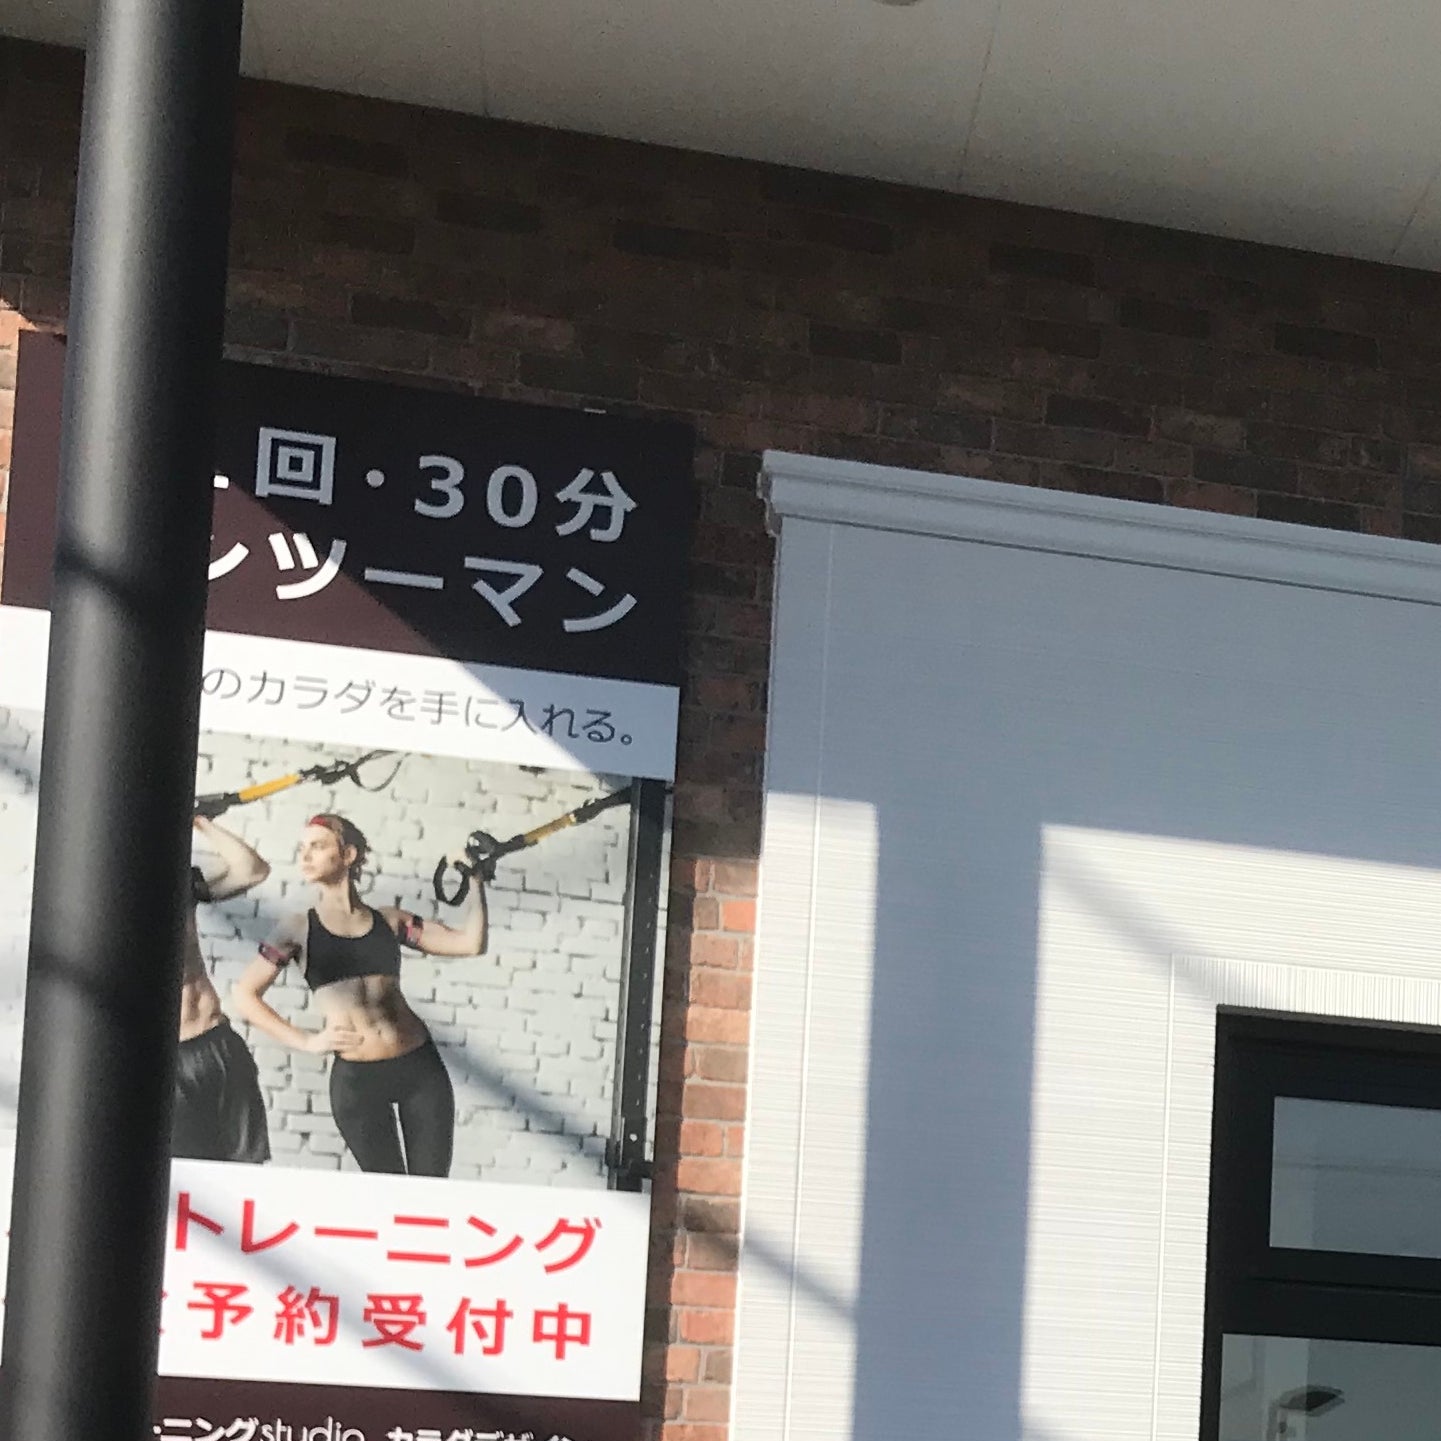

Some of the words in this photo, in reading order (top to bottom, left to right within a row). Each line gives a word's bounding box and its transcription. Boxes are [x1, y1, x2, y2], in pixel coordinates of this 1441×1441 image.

[213, 427, 637, 543] 回・30分
[202, 666, 634, 747] のカラダを手に入れる。
[174, 1192, 602, 1275] トレーニング
[159, 1280, 593, 1361] 予約受付中
